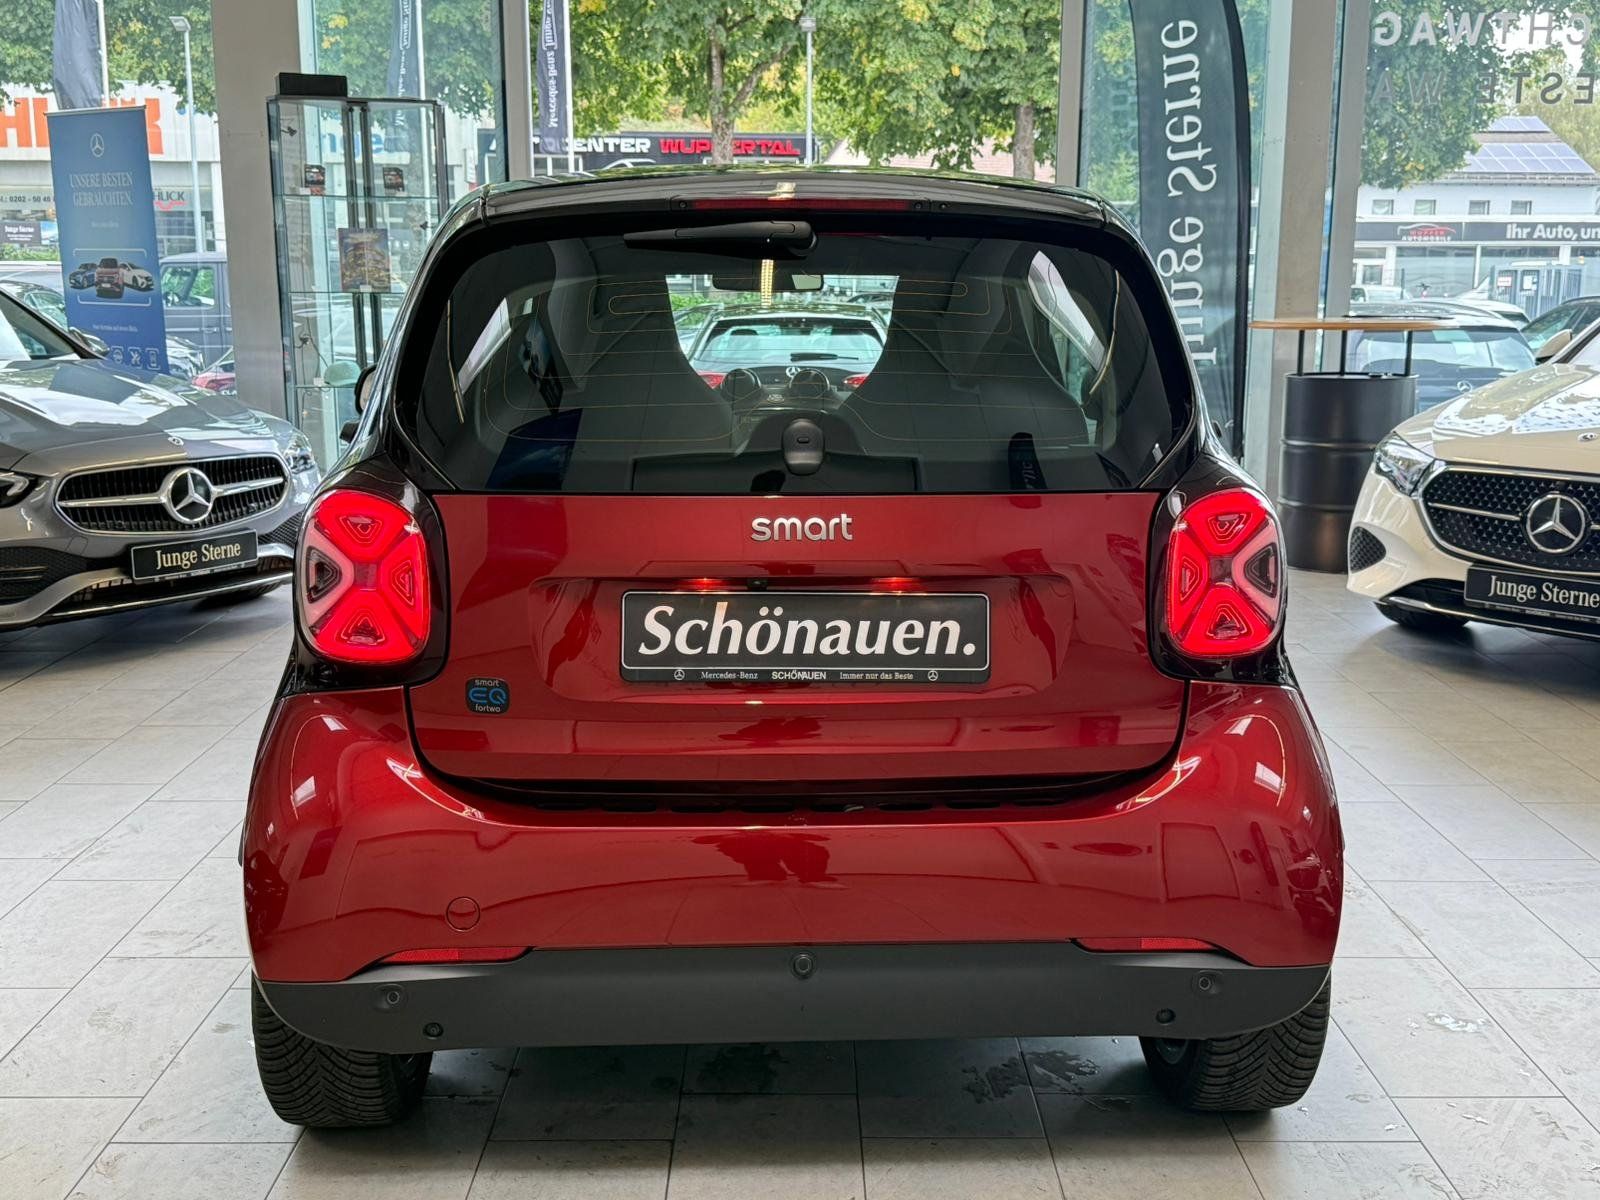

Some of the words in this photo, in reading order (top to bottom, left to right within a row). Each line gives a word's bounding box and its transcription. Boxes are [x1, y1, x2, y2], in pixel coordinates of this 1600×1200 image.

[659, 138, 800, 155] WUPERTAL
[69, 173, 100, 188] UNSERE
[102, 172, 133, 187] BESTEN
[1506, 223, 1530, 239] Ihr
[1532, 223, 1578, 240] Auto,
[751, 513, 854, 541] smart
[156, 550, 198, 570] Junge
[201, 543, 242, 562] Sterne
[1488, 575, 1537, 603] Junge
[1541, 581, 1600, 608] Sterne
[638, 601, 977, 656] Schönauen.
[474, 679, 500, 687] smart
[700, 671, 759, 681] Mercedes-Benz
[771, 669, 827, 681] SCHÖNAUEN
[840, 672, 863, 681] Immer
[865, 673, 878, 681] nur
[880, 672, 892, 681] das
[894, 672, 914, 681] Beste
[468, 687, 507, 705] EQ
[475, 703, 501, 713] fortwo
